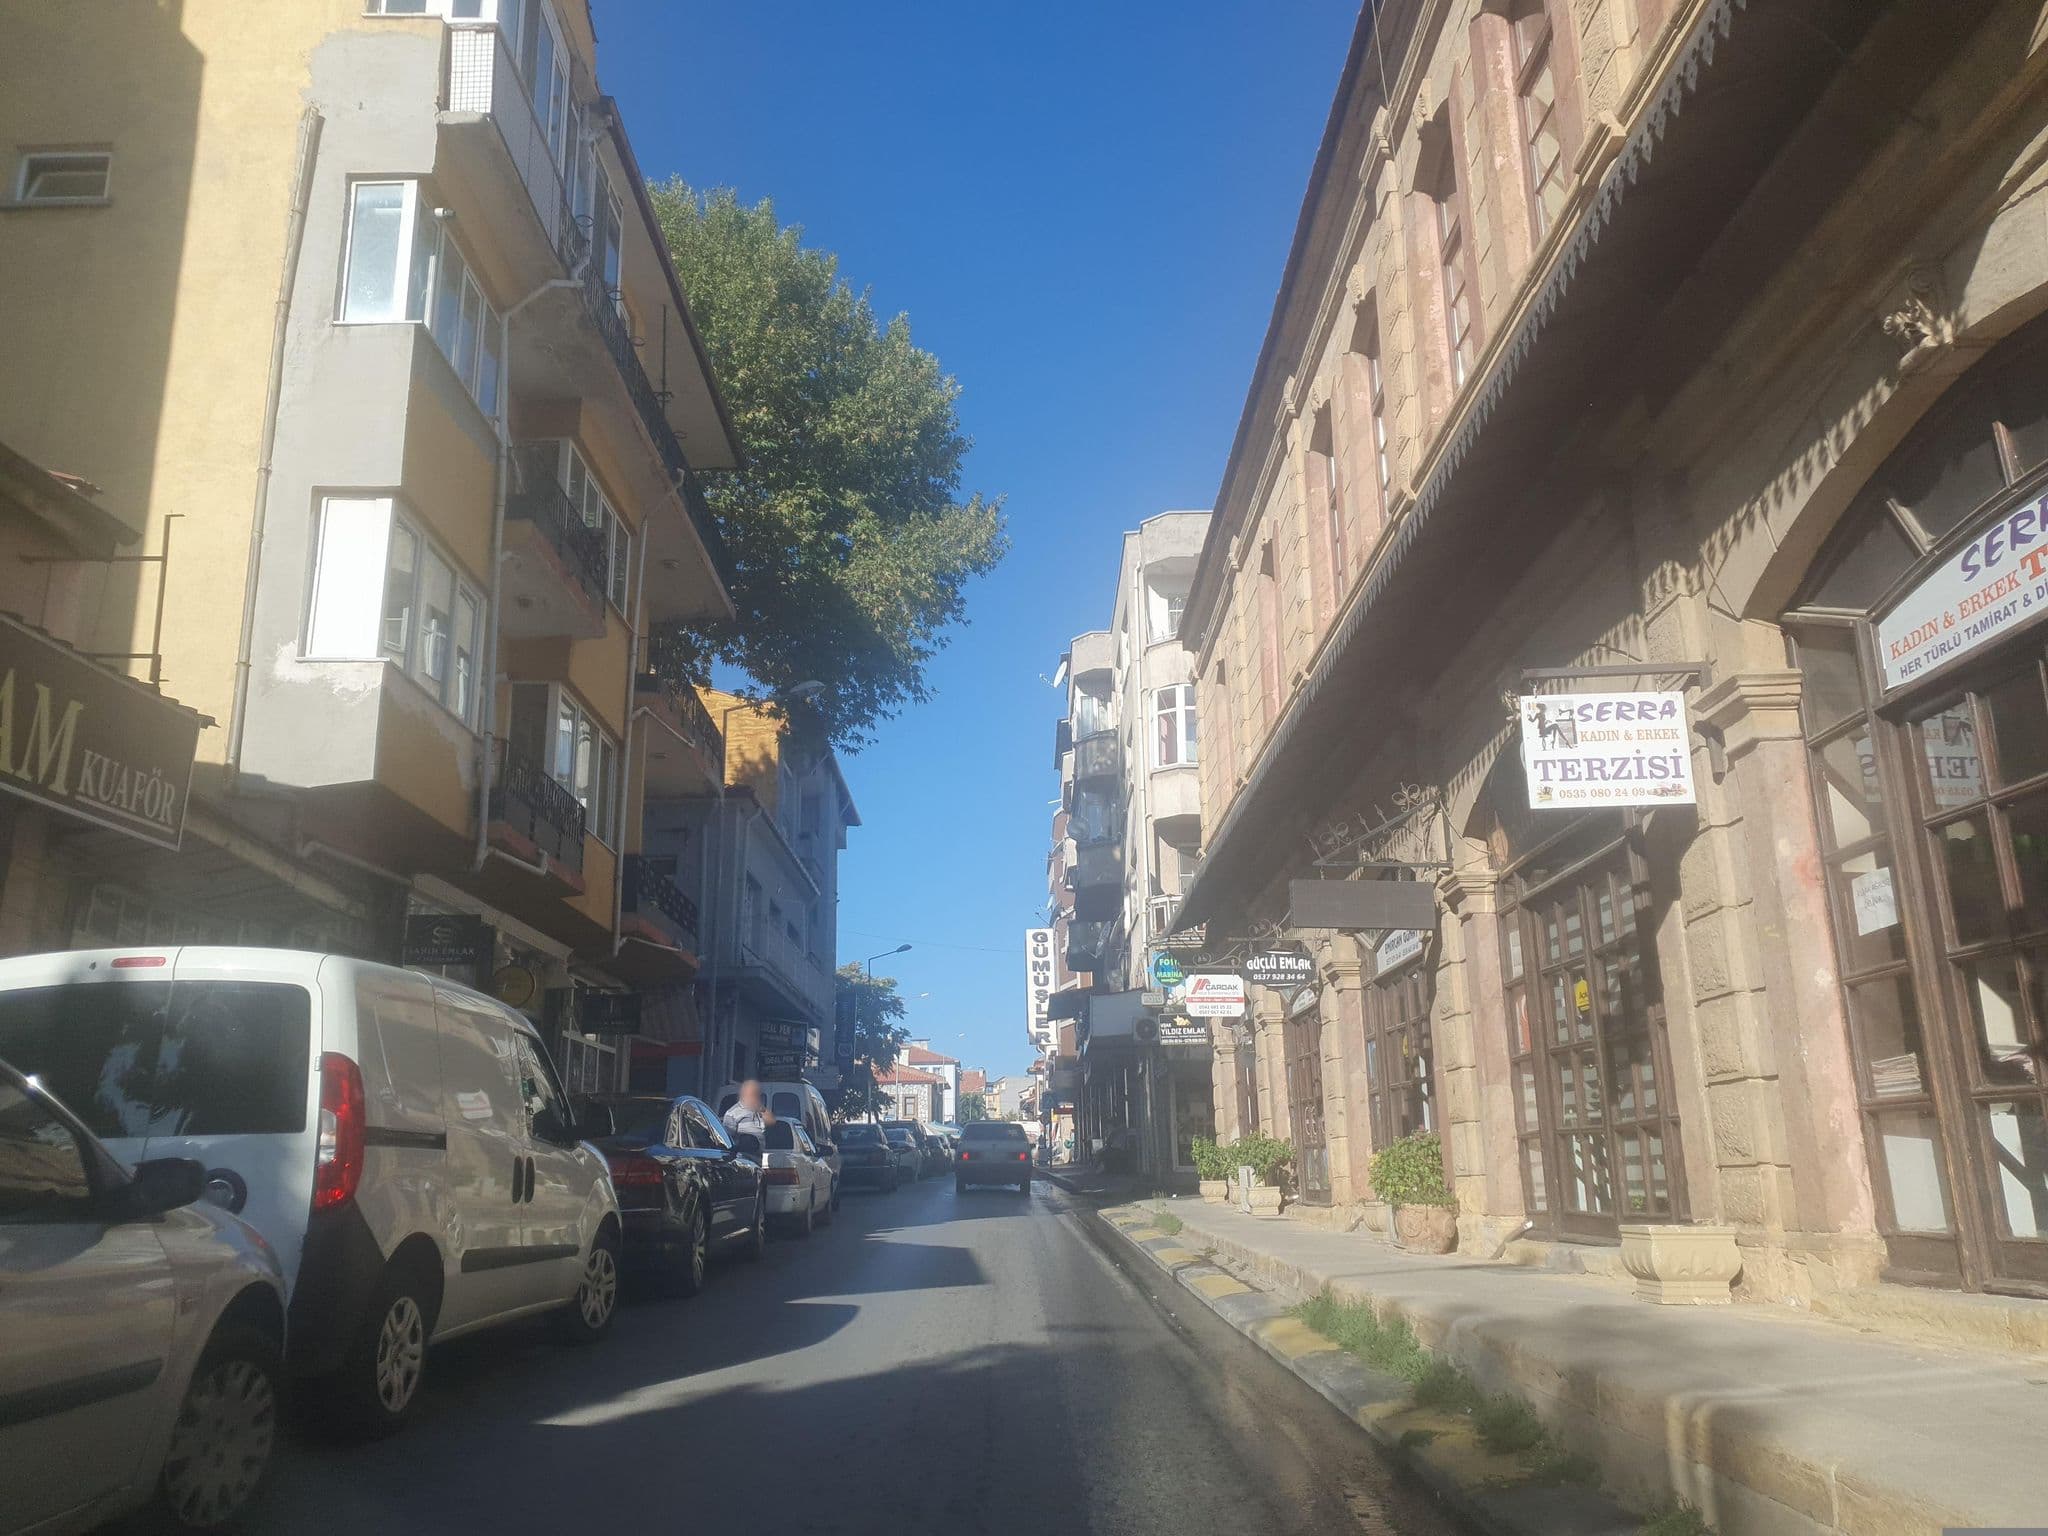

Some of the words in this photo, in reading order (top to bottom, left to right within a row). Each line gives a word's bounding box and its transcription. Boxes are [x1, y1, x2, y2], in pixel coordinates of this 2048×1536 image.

[1889, 618, 1939, 660] KADIN
[1942, 612, 1955, 629] &
[1957, 570, 2022, 620] ERKEK
[1899, 658, 1922, 679] HER
[1923, 632, 1962, 667] TÜRLÜ
[1963, 600, 2018, 641] TAMİRAT
[2022, 592, 2032, 607] &
[1577, 700, 1677, 723] SERRA
[1580, 729, 1620, 742] KADIN
[1623, 730, 1633, 742] &
[1637, 728, 1681, 741] ERKEK
[1533, 748, 1685, 782] TERZİSİ
[78, 748, 177, 825] KUAFÖR
[1559, 789, 1587, 799] 0535
[1590, 788, 1611, 798] 080
[1614, 788, 1628, 797] 24
[1246, 954, 1277, 973] GÜÇLÜ
[1279, 956, 1312, 970] EMLAK
[1032, 931, 1051, 1044] GÜMÜŞLER
